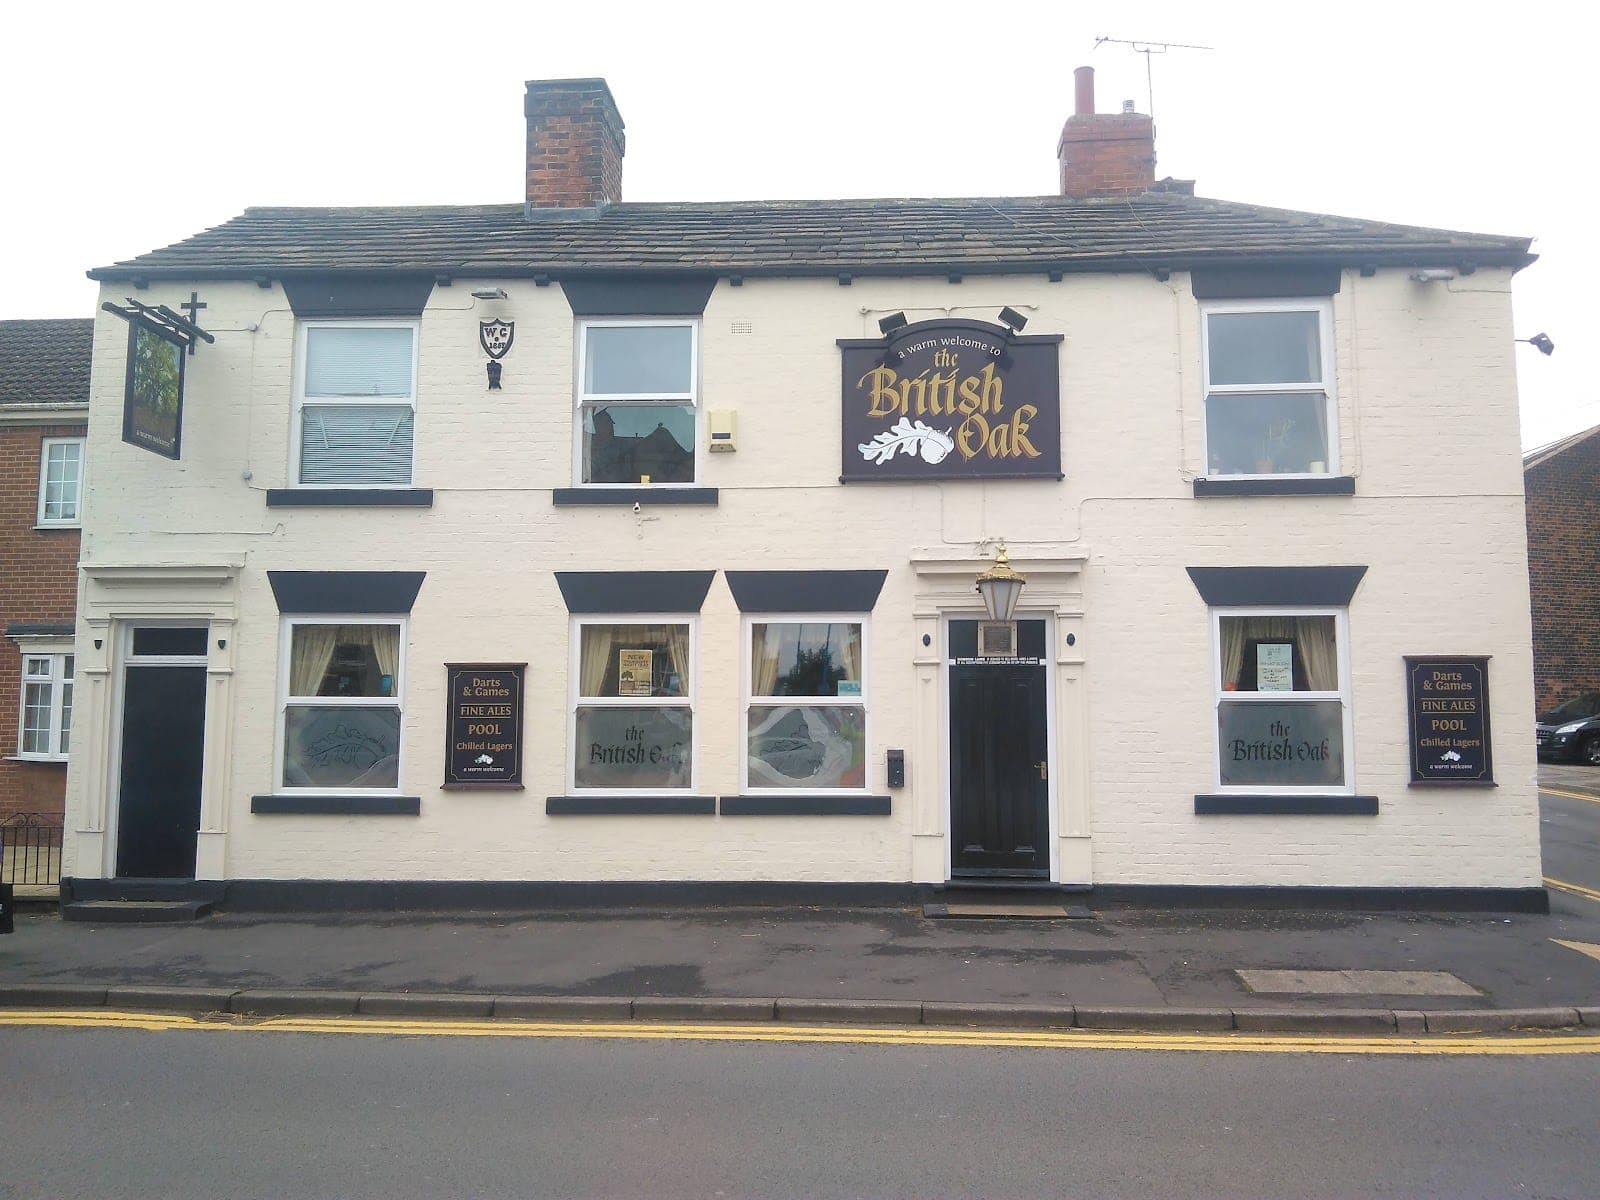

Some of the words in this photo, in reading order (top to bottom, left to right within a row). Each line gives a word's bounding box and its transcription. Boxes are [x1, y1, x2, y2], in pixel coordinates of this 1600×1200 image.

[484, 328, 497, 337] W
[897, 350, 906, 359] a
[906, 339, 937, 354] warm
[940, 335, 988, 351] welcome
[989, 345, 1001, 356] to
[934, 348, 959, 368] the
[856, 362, 1005, 420] British
[956, 404, 1043, 464] Oak
[1433, 671, 1462, 681] Darts
[473, 678, 501, 687] Darts
[1423, 680, 1433, 690] &
[1436, 681, 1473, 691] Games
[463, 686, 472, 696] &
[475, 687, 509, 697] Games
[461, 706, 485, 716] FINE
[487, 706, 512, 716] ALES
[1422, 701, 1448, 711] FINE
[1450, 701, 1476, 711] ALES
[468, 724, 502, 735] POOL
[1270, 720, 1290, 736] the
[1431, 719, 1467, 731] POOL
[625, 725, 645, 741] the
[456, 741, 485, 750] Chilled
[487, 742, 513, 752] Lagers
[1421, 738, 1450, 747] Chilled
[1453, 738, 1480, 749] Lagers
[590, 742, 645, 765] British
[1227, 738, 1293, 761] British
[1297, 738, 1330, 761] Oak
